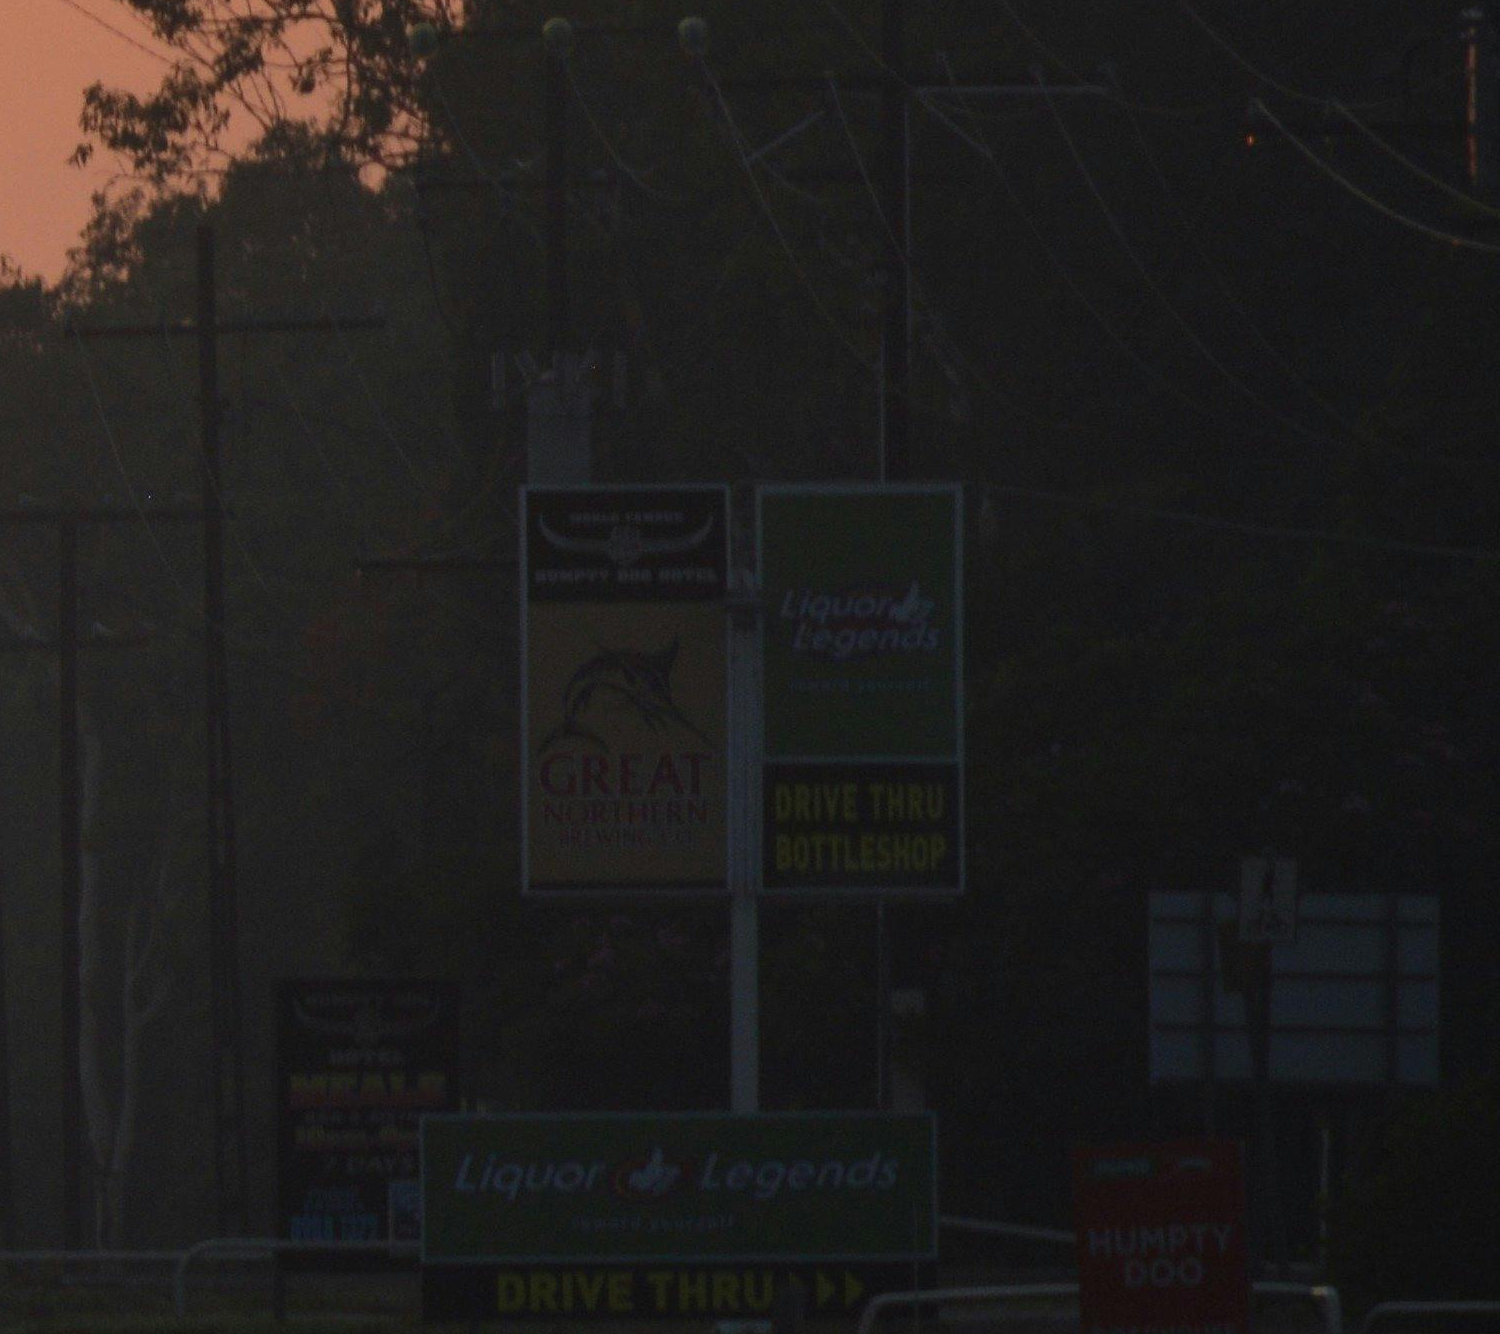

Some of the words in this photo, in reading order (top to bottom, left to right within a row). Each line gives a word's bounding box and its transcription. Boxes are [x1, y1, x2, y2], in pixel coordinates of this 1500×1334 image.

[780, 587, 894, 625] Liquor
[792, 620, 940, 660] Legends
[540, 752, 712, 796] GREAT
[544, 799, 707, 825] NORTHERN
[775, 782, 859, 822] DRIVE
[868, 782, 945, 821] THRU
[776, 833, 947, 872] BOTTLESHOP
[454, 1152, 605, 1202] Liquor
[701, 1149, 900, 1200] Legends
[1087, 1223, 1233, 1259] HUMPTY
[496, 1270, 633, 1313] DRIVE
[646, 1270, 776, 1312] THRU
[1123, 1256, 1204, 1288] DOO
